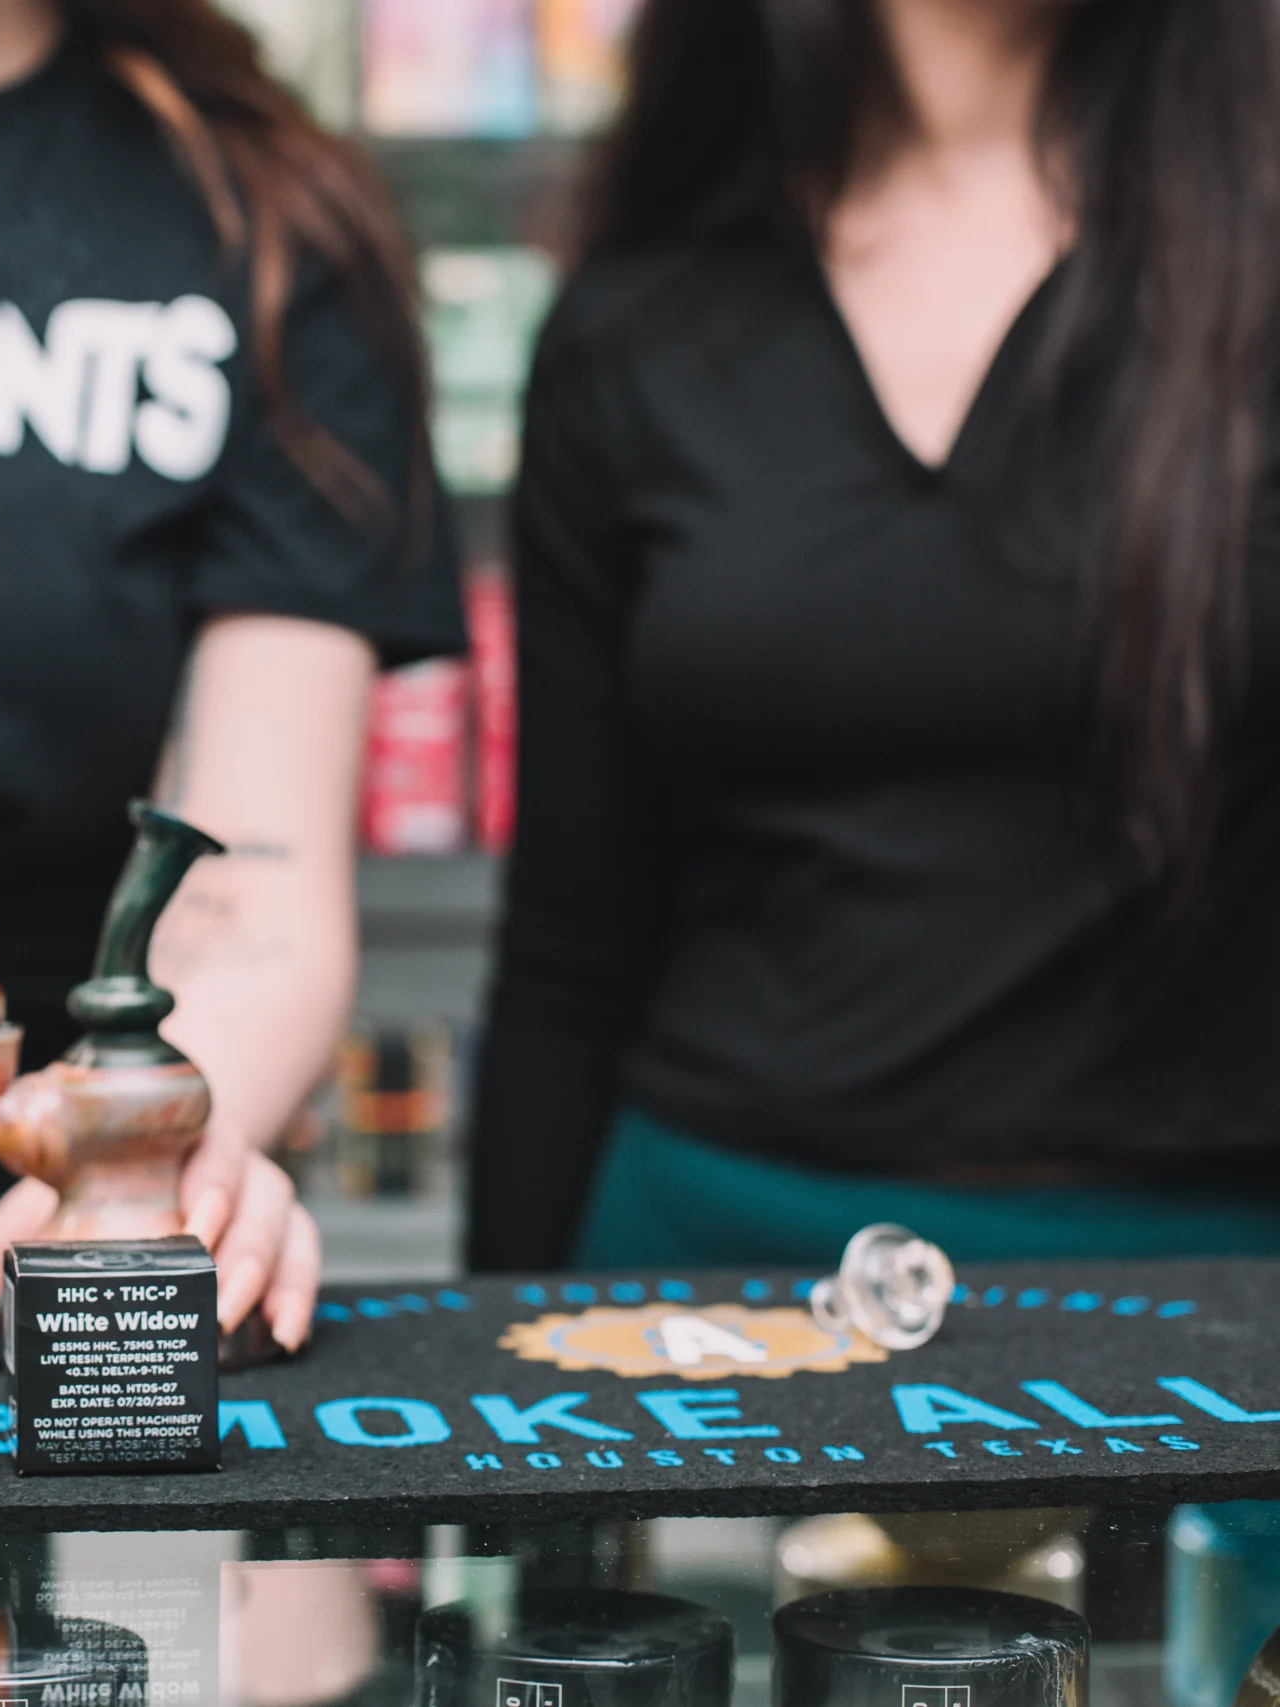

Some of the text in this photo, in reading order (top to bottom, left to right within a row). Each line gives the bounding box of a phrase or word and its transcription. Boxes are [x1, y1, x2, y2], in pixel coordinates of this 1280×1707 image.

[57, 1287, 98, 1303] HHC
[119, 1285, 178, 1302] THC-P
[36, 1310, 199, 1333] White Widow
[52, 1339, 188, 1352] 855MG HHC, 75MG THCP
[40, 1351, 199, 1365] LIVE RESIN TERPENES 70MG
[65, 1365, 175, 1377] <0.3% DELTA-9-THC
[59, 1382, 178, 1395] BATCH NO. HTDS-07
[51, 1395, 186, 1409] EXP. DATE: 07/20/2023
[33, 1414, 203, 1428] DO NOT OPERATE MACHINERY
[38, 1426, 199, 1440] WHILE USING THIS PRODUCT
[35, 1437, 202, 1451] MAY CAUSE A POSITIVE DRUG
[49, 1450, 186, 1463] TEST AND INTOXICATION
[465, 1434, 1201, 1471] HOUSTON TEXAS
